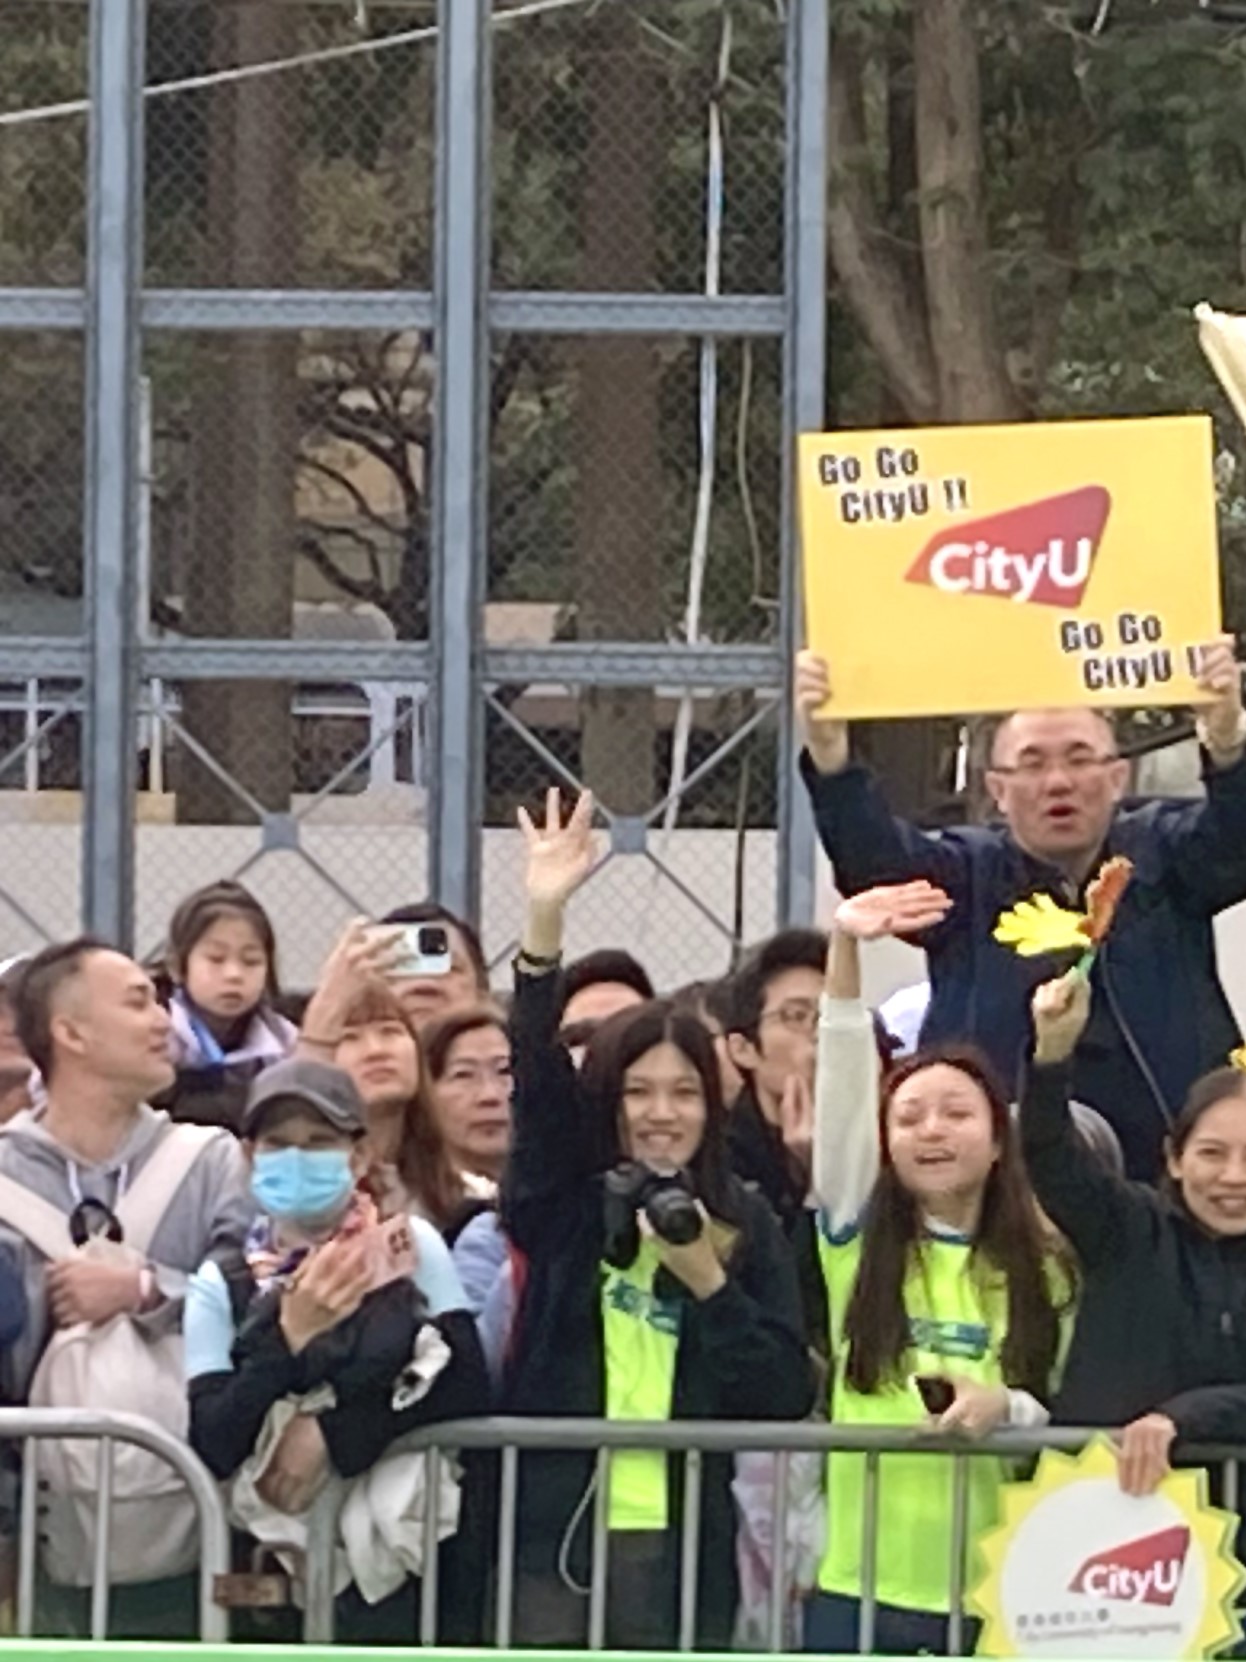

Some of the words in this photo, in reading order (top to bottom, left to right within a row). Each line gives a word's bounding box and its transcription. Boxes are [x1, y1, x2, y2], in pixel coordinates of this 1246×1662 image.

[818, 454, 861, 486] Go
[876, 447, 919, 478] Go
[840, 484, 929, 523] CityU
[943, 479, 969, 511] !!
[929, 536, 1092, 602] CityU
[1061, 620, 1104, 652] Go
[1118, 614, 1162, 645] Go
[1083, 648, 1172, 690] CityU
[1083, 1559, 1180, 1603] CityU
